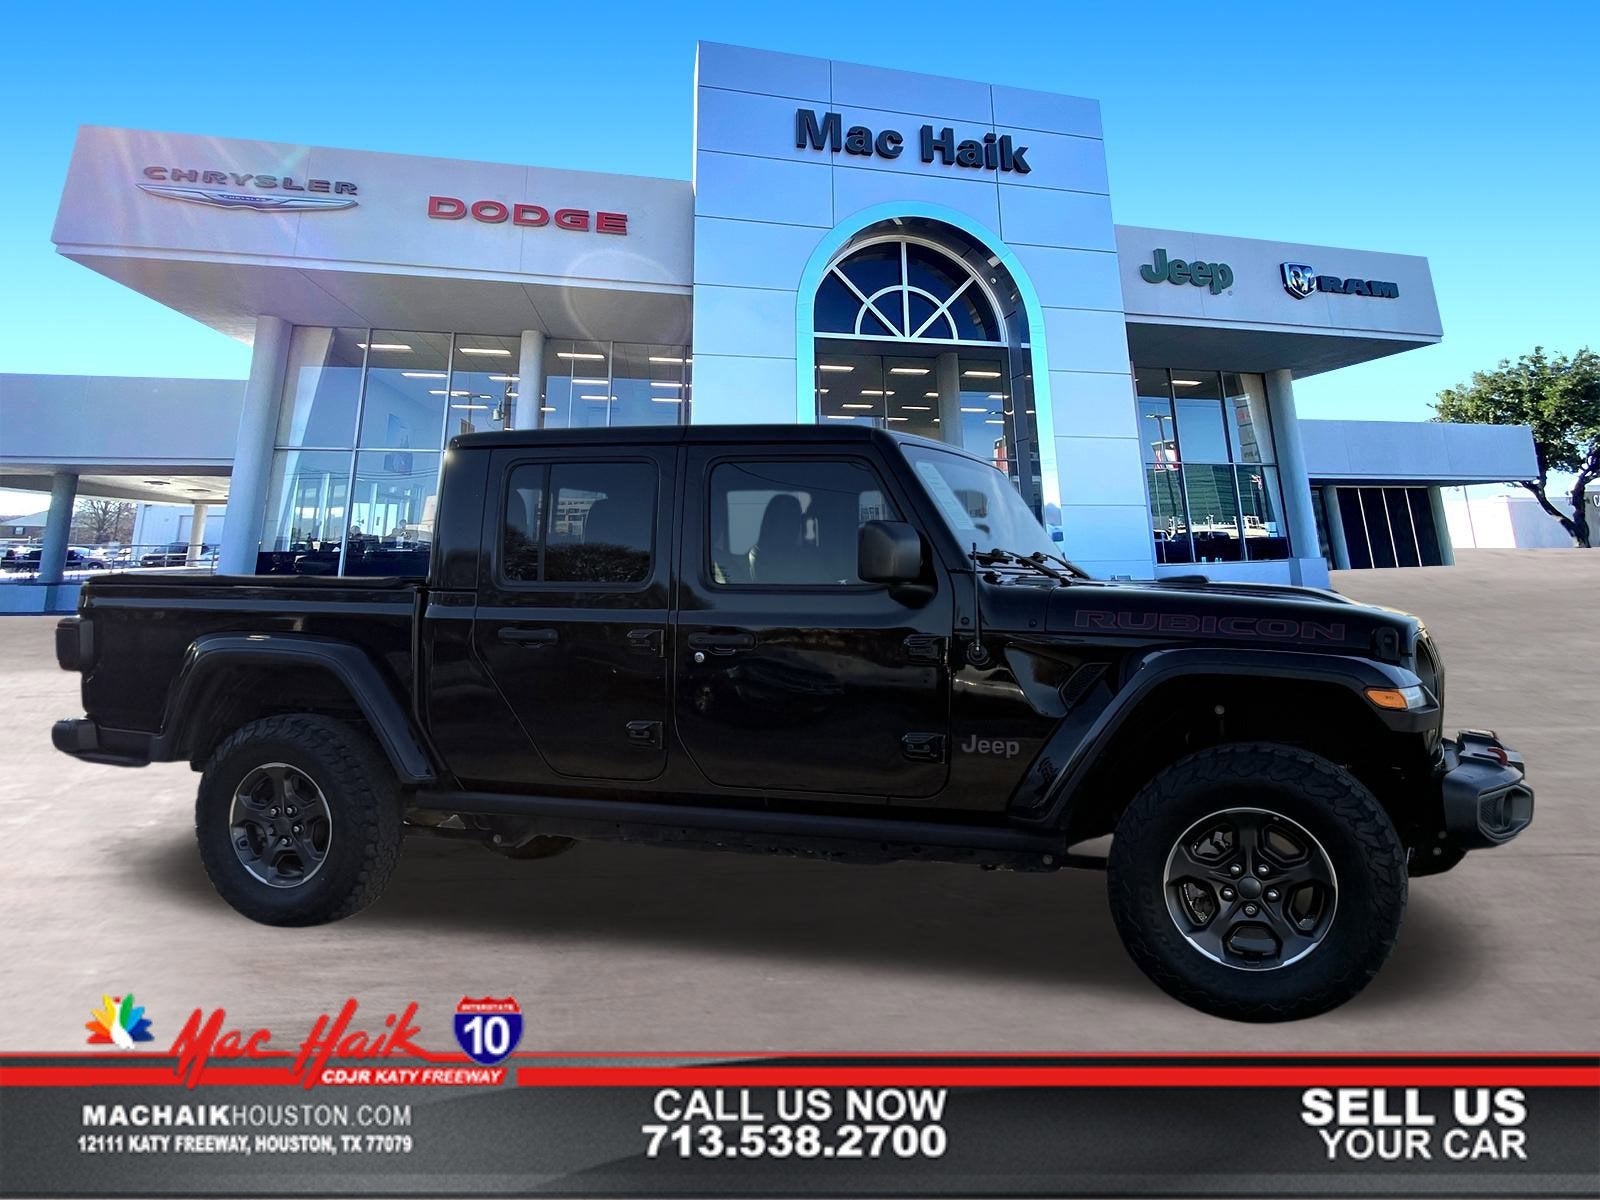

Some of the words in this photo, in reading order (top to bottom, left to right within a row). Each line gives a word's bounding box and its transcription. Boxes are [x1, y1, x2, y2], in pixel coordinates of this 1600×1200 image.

[796, 108, 904, 159] Mac
[920, 124, 1032, 174] Haik
[143, 166, 358, 196] CHRYSLER
[428, 196, 628, 236] DODGE
[1140, 248, 1234, 296] Jeep
[1316, 275, 1399, 298] RAM
[1074, 609, 1346, 641] RUBICON
[961, 734, 1020, 759] Jeep
